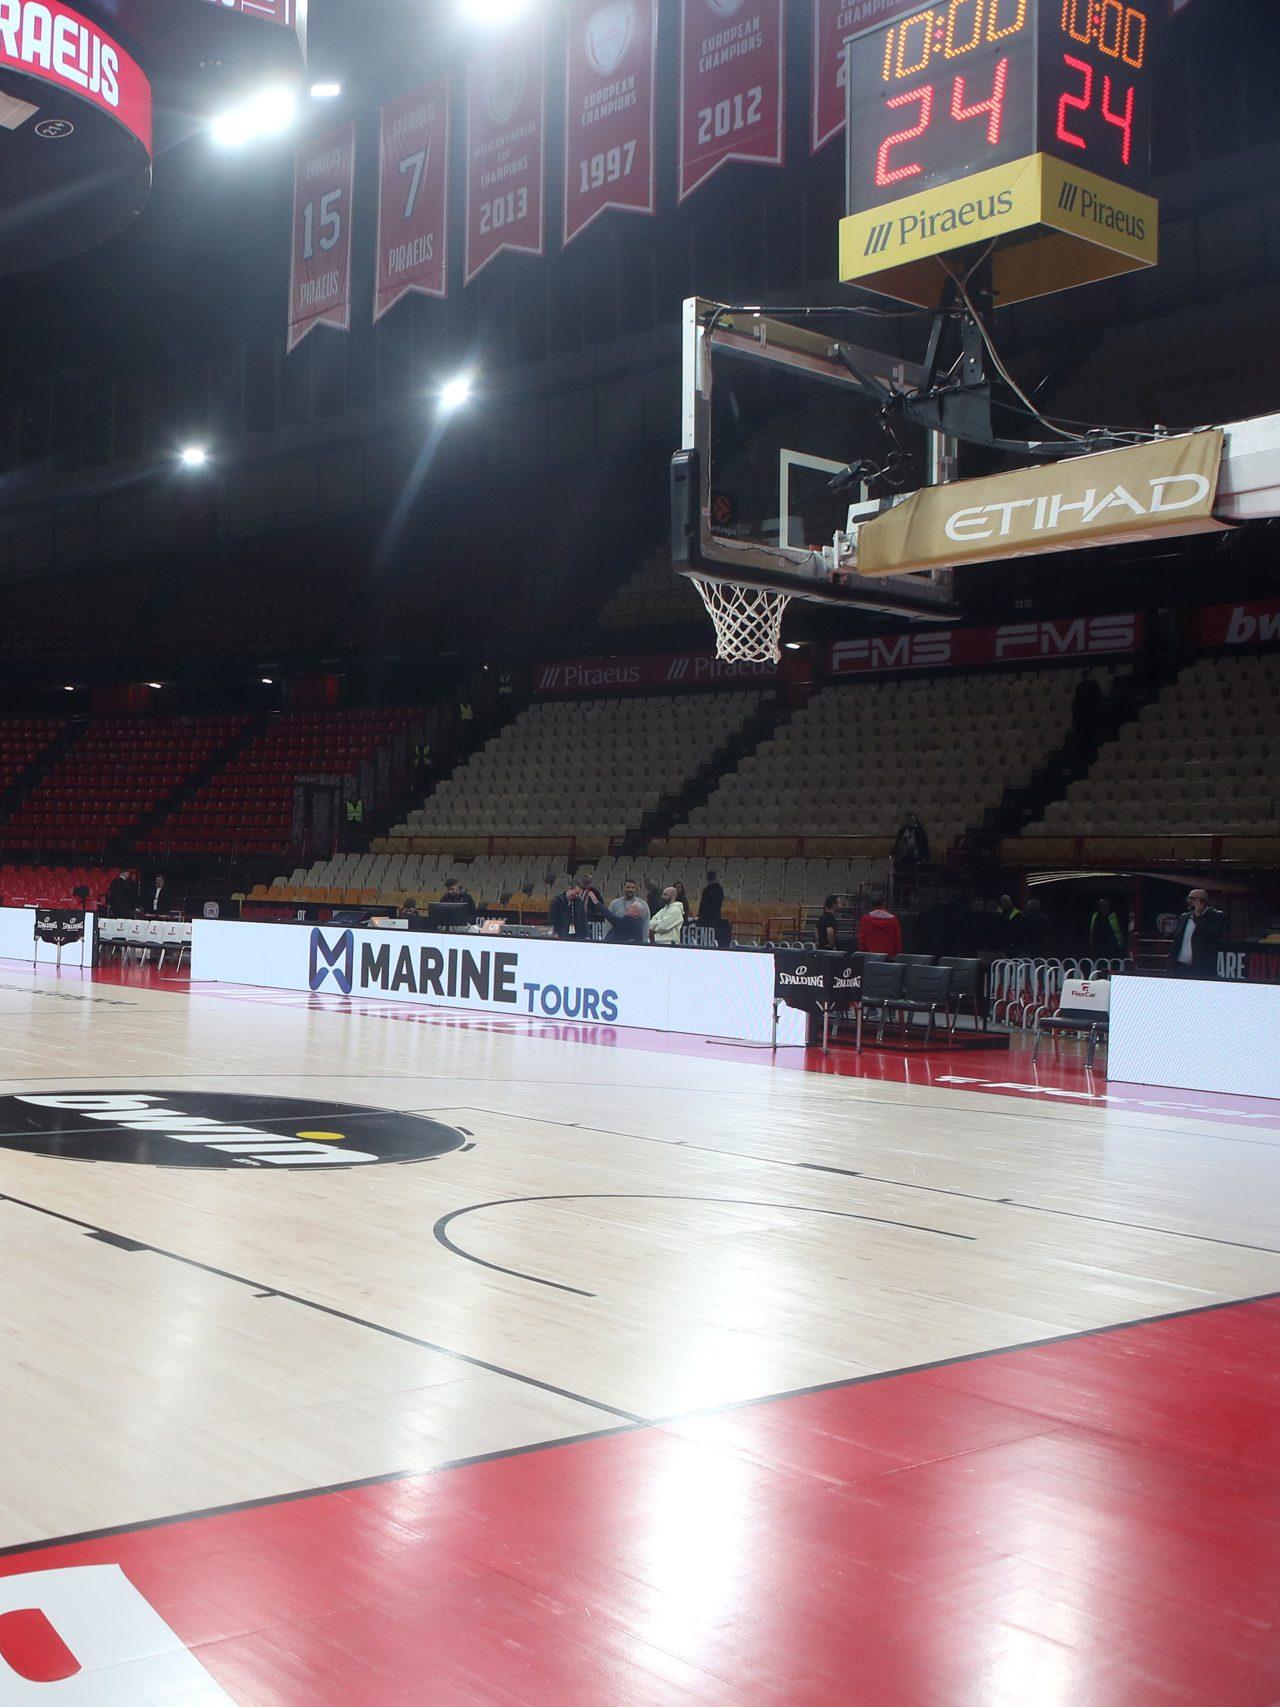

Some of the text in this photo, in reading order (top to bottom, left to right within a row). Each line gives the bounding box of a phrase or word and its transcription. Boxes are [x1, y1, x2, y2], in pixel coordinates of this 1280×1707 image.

[699, 32, 763, 73] CHAMPIONS
[702, 15, 760, 55] EUROPEAN
[581, 90, 637, 127] CHAMPIONS
[584, 75, 635, 110] EUROPEAN
[1056, 54, 1135, 165] 24
[698, 86, 762, 145] 2012
[875, 57, 1008, 186] 24
[399, 149, 428, 218] 7
[480, 154, 528, 189] CHAMPIONS
[579, 140, 637, 194] 1997
[302, 187, 343, 260] 15
[479, 186, 528, 235] 2013
[898, 189, 1014, 246] Piraeus
[1080, 188, 1145, 241] Piraeus
[388, 233, 434, 275] PIRAEUS
[299, 270, 339, 308] PIRAEUS
[944, 473, 1211, 542] ETIHAD
[832, 631, 951, 671] FMS
[995, 614, 1135, 658] FMS
[563, 665, 640, 687] Piraeus
[694, 656, 779, 679] Piraeus
[361, 943, 619, 1022] MARINE TOURS
[780, 972, 824, 988] SPALDING
[832, 976, 861, 989] SPALDING
[15, 1094, 380, 1165] bwin
